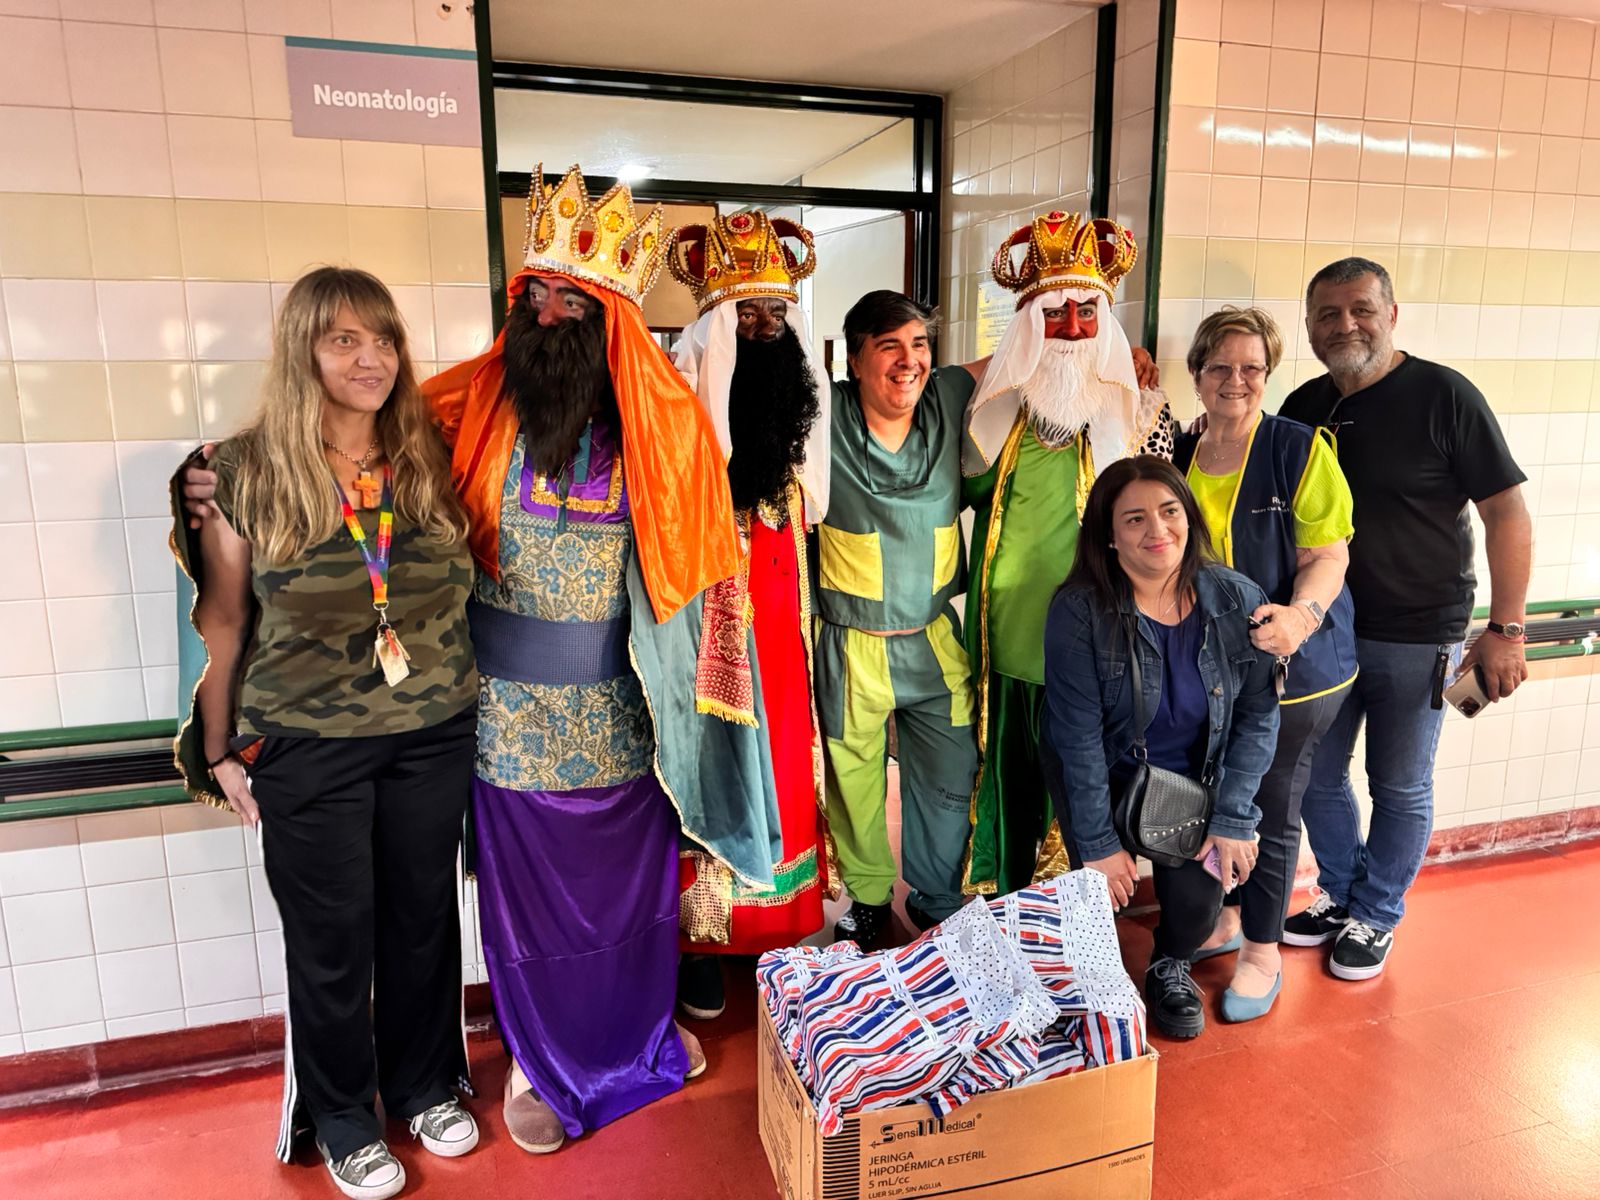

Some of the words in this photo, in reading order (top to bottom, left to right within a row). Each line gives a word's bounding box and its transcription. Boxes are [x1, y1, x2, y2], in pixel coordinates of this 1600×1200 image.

[313, 84, 458, 119] Neonatología
[868, 1151, 915, 1166] JERINGA
[868, 1158, 945, 1177] HIPODÉRMICA
[947, 1150, 987, 1165] ESTÉRIL
[868, 1180, 875, 1189] 5
[878, 1177, 910, 1187] mL/cc
[868, 1191, 887, 1199] LUER
[905, 1185, 917, 1194] SIN
[918, 1181, 942, 1191] AGUJA
